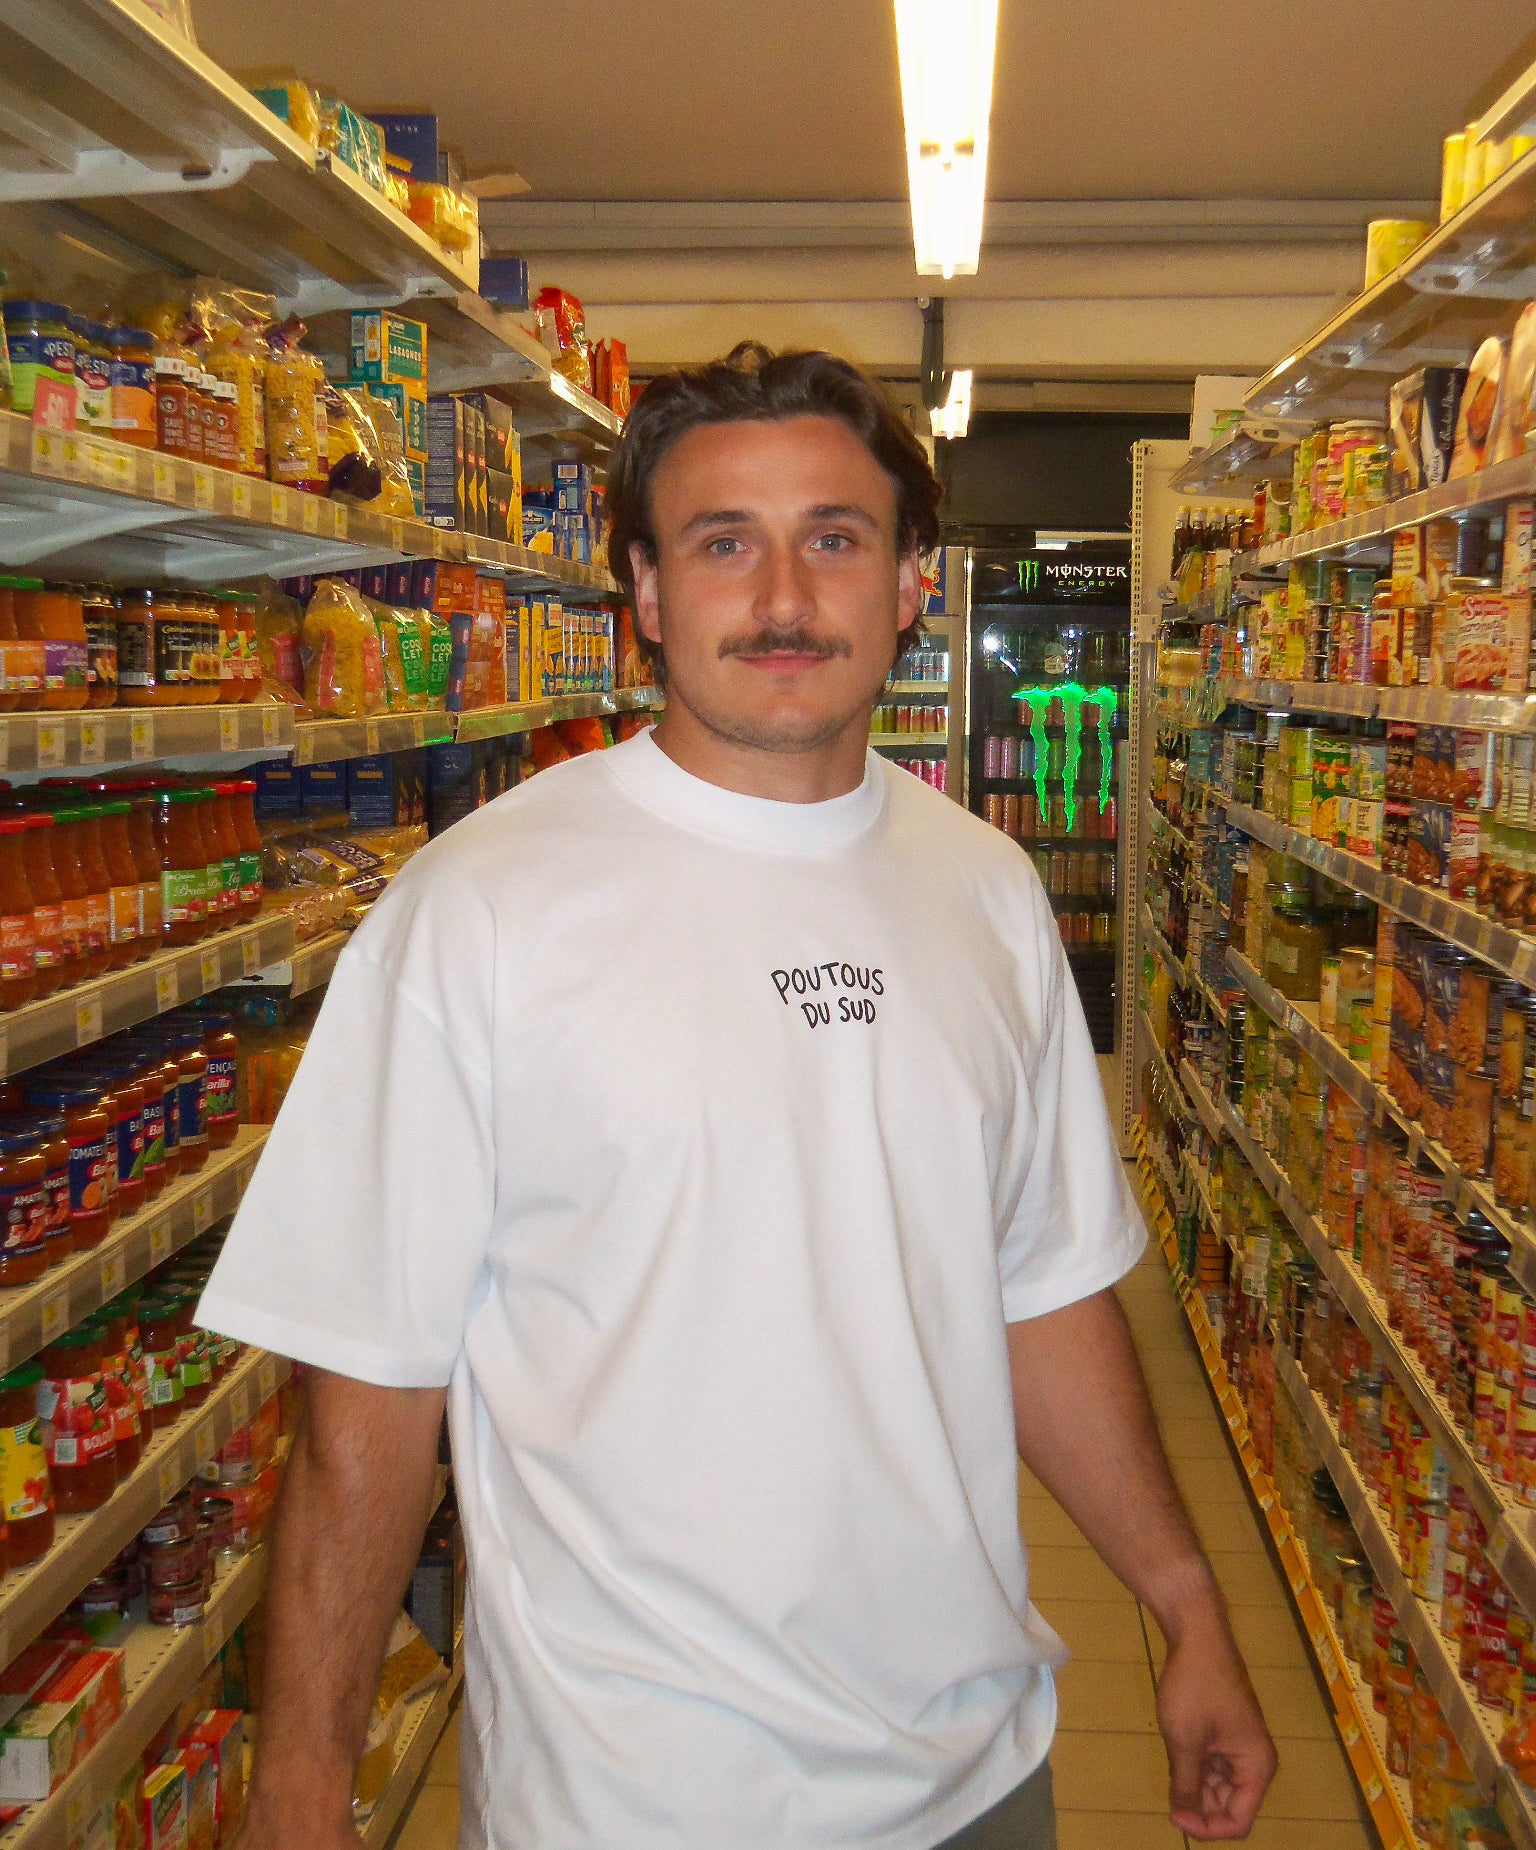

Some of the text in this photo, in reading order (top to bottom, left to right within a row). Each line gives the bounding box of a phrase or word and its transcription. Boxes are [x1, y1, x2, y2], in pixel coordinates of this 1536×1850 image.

[771, 962, 885, 1005] POUTOUS
[801, 997, 876, 1029] DU SUD
